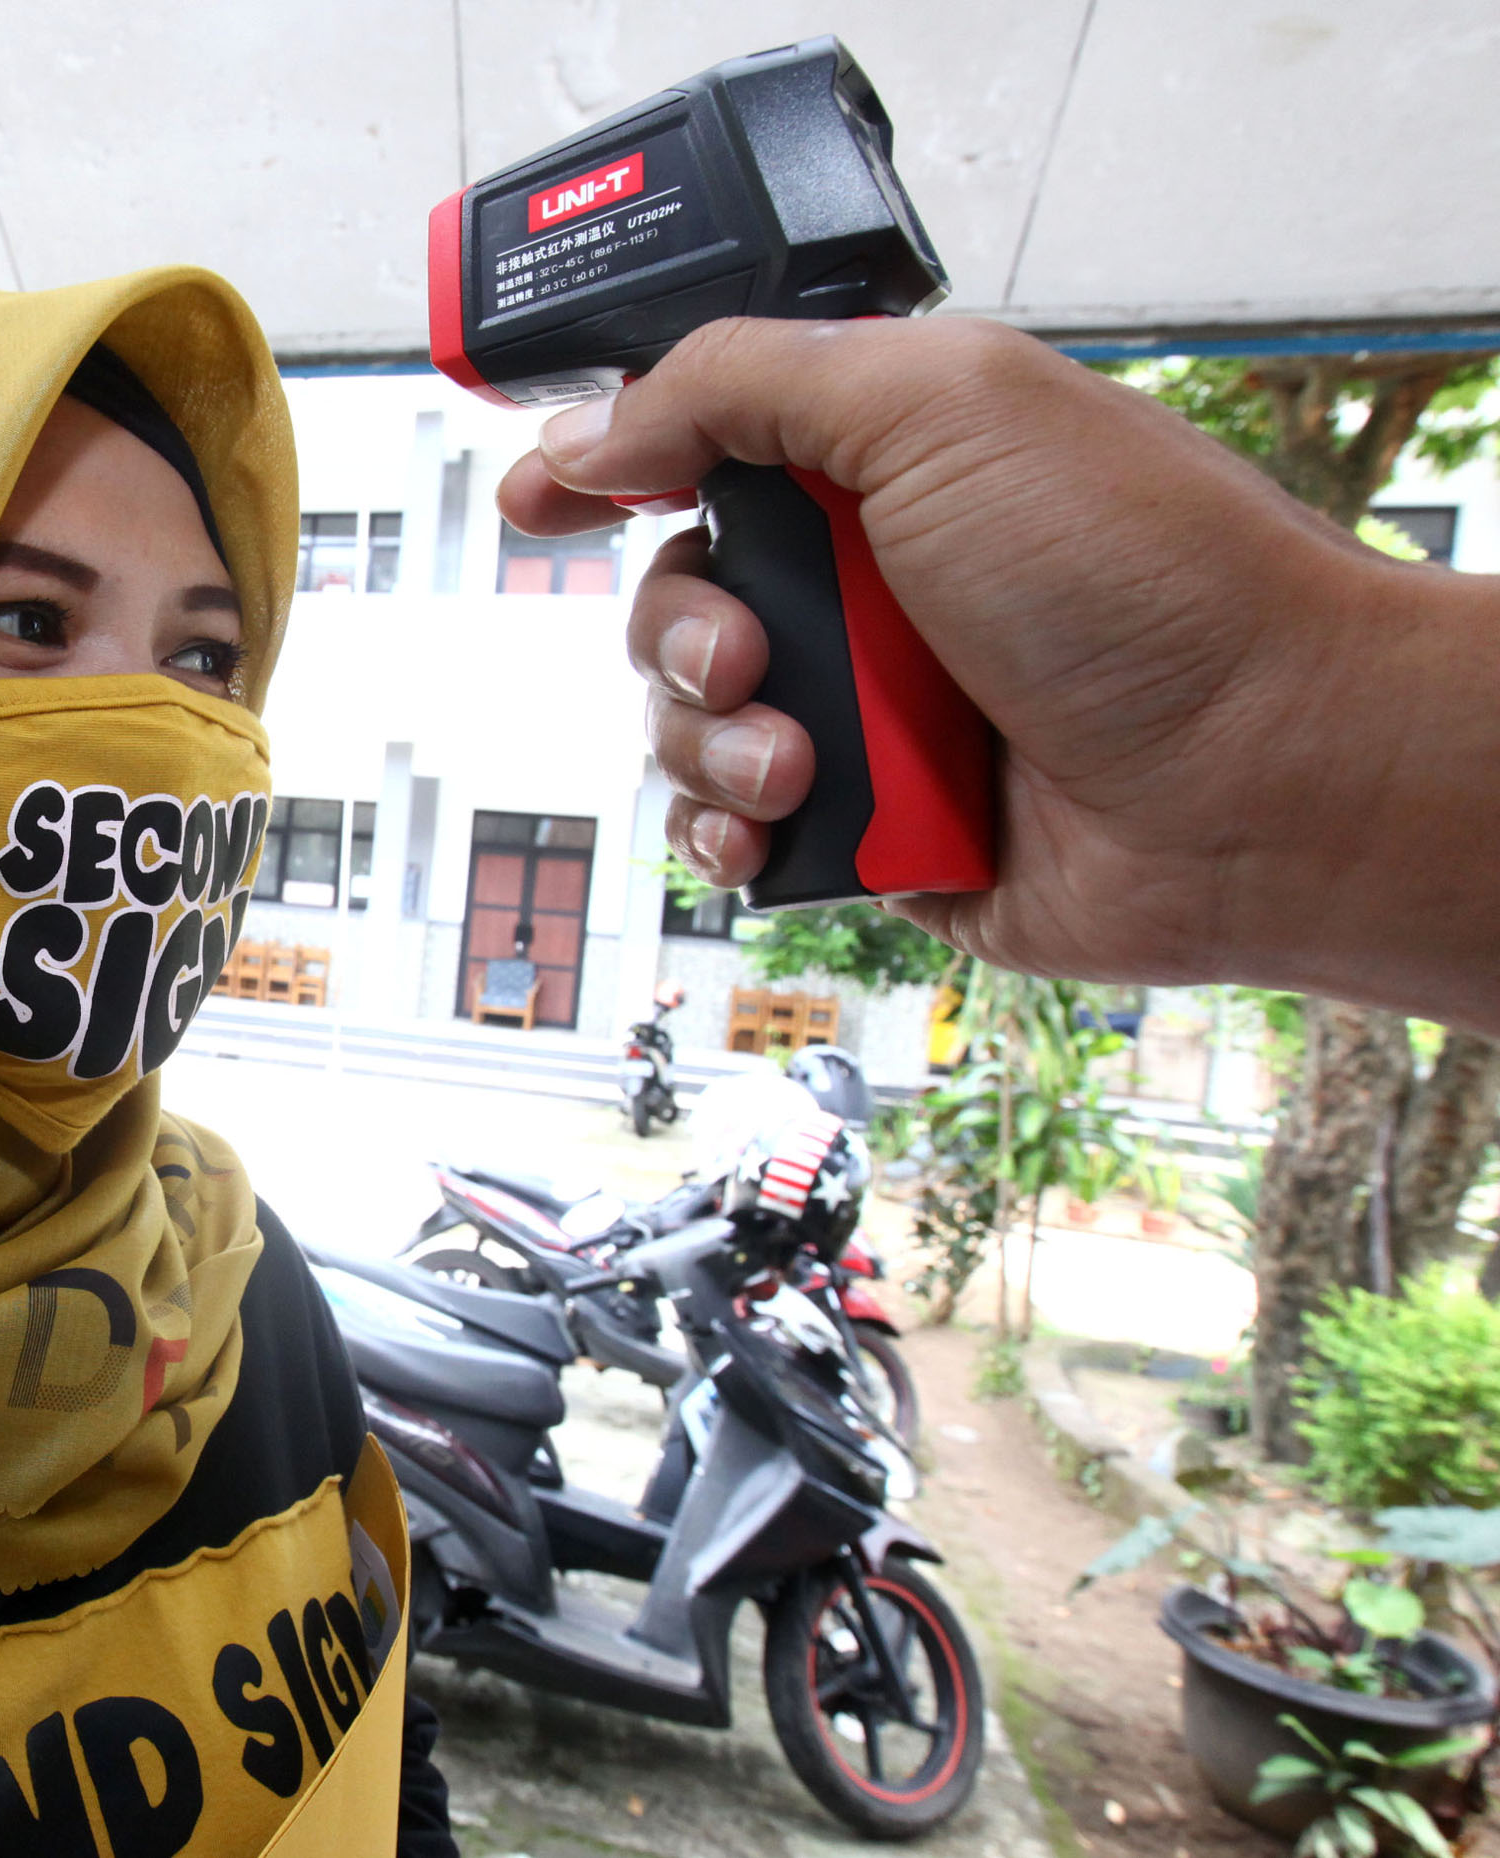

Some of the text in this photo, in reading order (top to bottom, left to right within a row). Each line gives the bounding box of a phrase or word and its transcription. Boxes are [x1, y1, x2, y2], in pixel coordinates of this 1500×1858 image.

[542, 166, 630, 220] UNI-T
[496, 201, 683, 276] 非接触式红外测温仪 UT302H+
